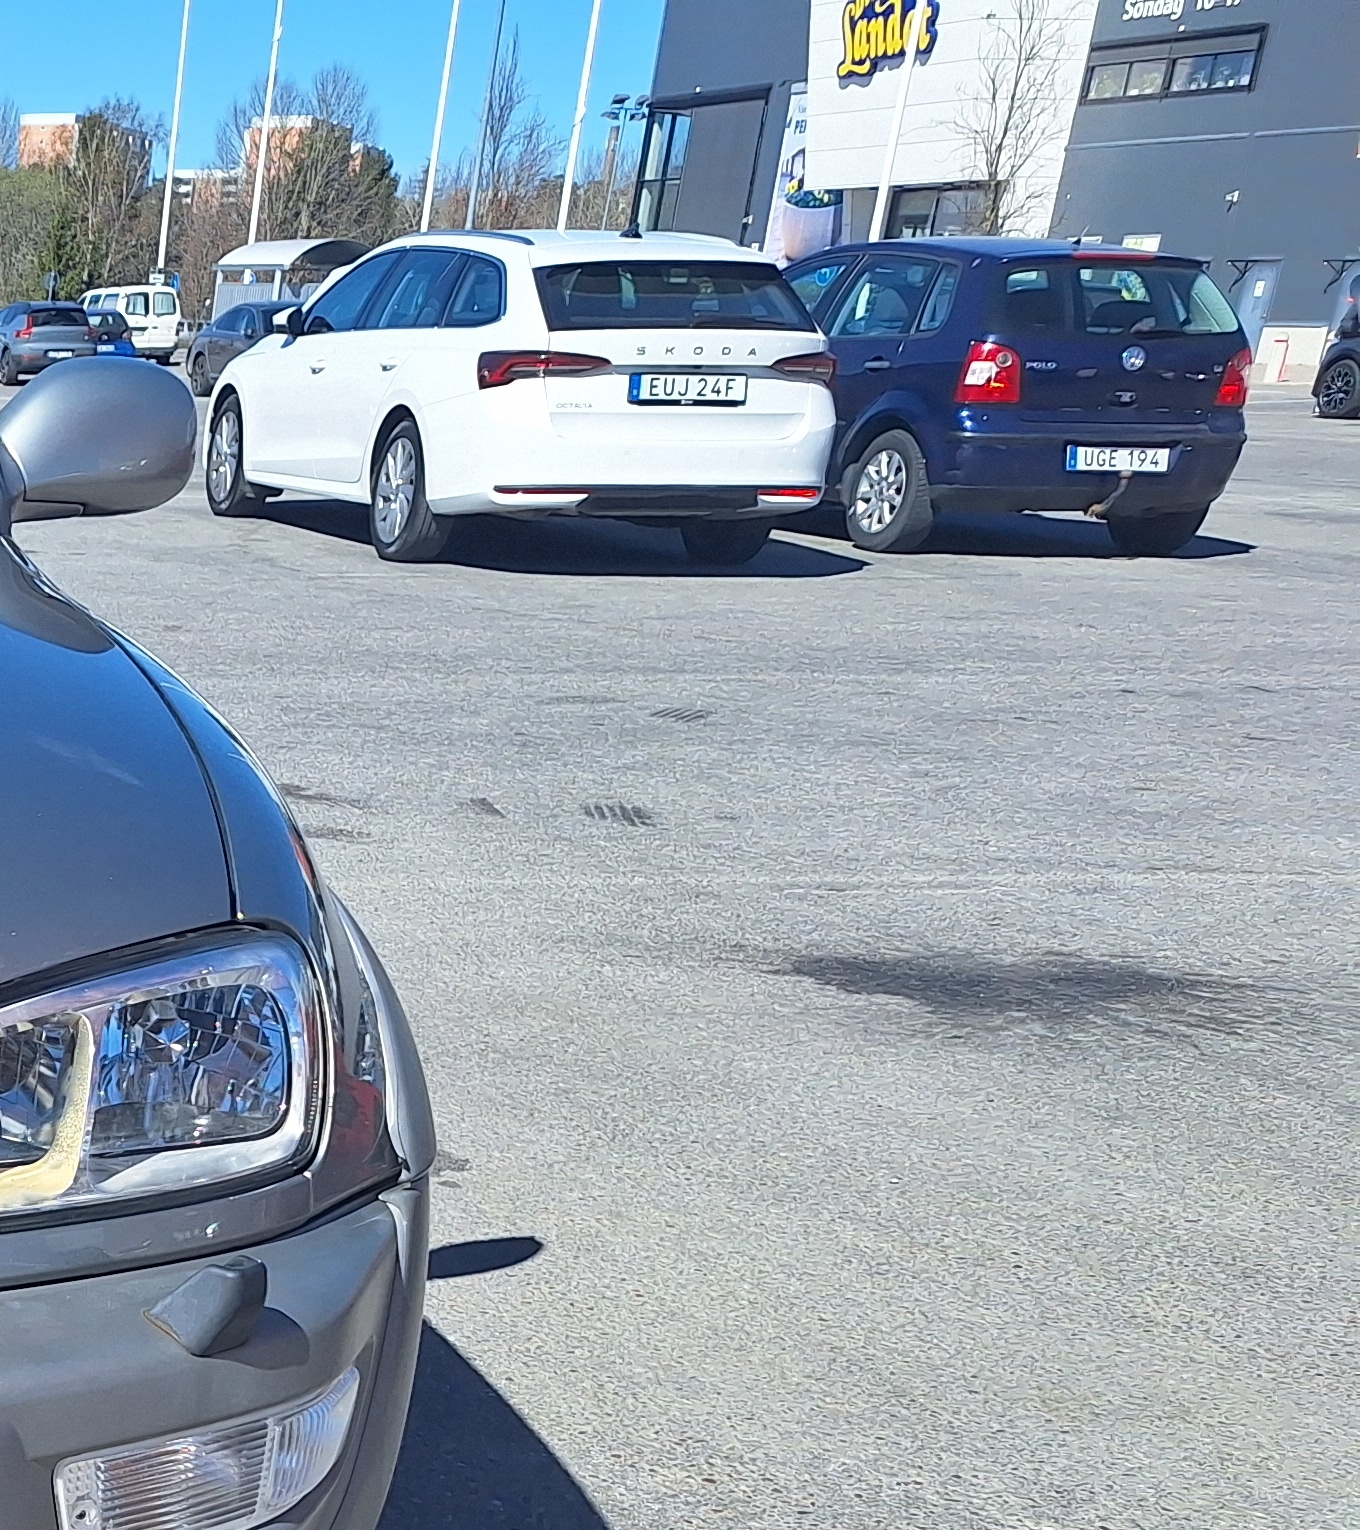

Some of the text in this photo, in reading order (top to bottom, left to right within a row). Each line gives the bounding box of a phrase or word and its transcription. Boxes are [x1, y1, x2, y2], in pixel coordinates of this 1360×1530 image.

[636, 346, 757, 356] SKODA
[1025, 361, 1057, 371] POLO
[649, 377, 737, 397] EUJ 24F
[1084, 449, 1160, 468] UGE 194
